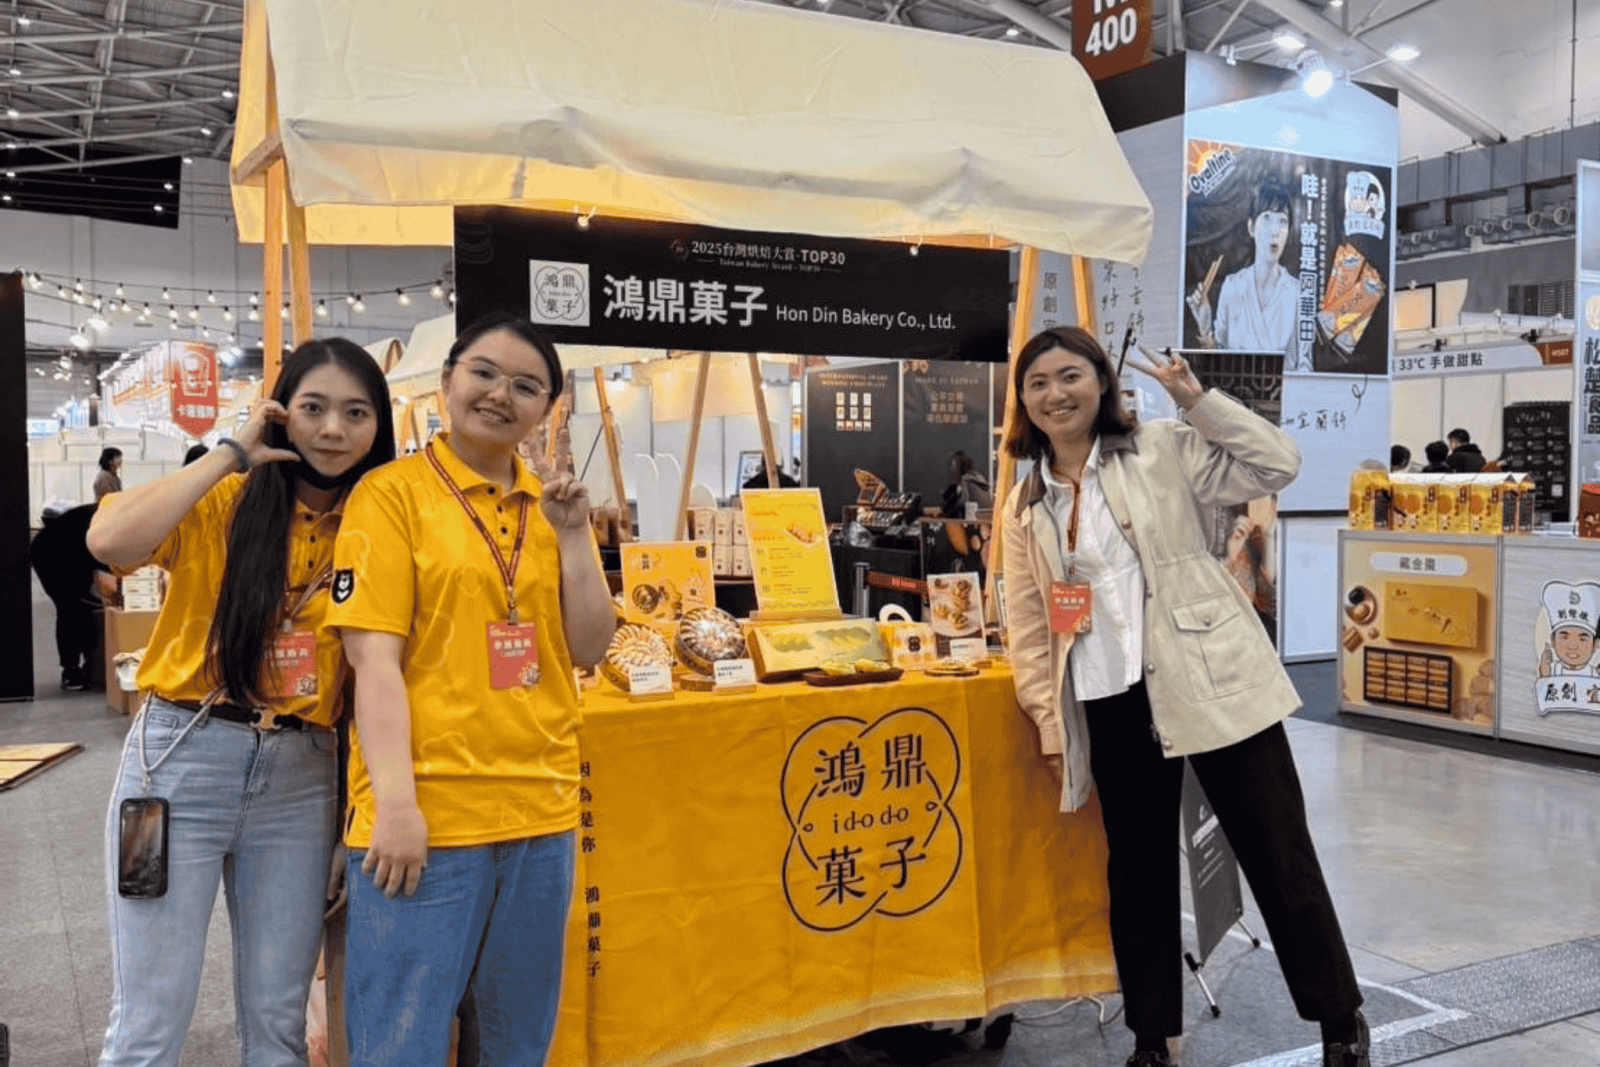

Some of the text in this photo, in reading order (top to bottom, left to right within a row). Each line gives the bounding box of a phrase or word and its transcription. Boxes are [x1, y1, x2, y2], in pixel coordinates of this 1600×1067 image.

[1085, 7, 1137, 57] 400
[1190, 149, 1231, 190] Ovaltine
[801, 250, 846, 265] TOP30
[603, 274, 768, 327] 鴻鼎菓子
[776, 304, 956, 331] Hon Din Bakery Co., Ltd.
[1430, 352, 1483, 369] 手做甜點
[814, 734, 926, 797] 鴻鼎
[816, 836, 926, 906] 菓子
